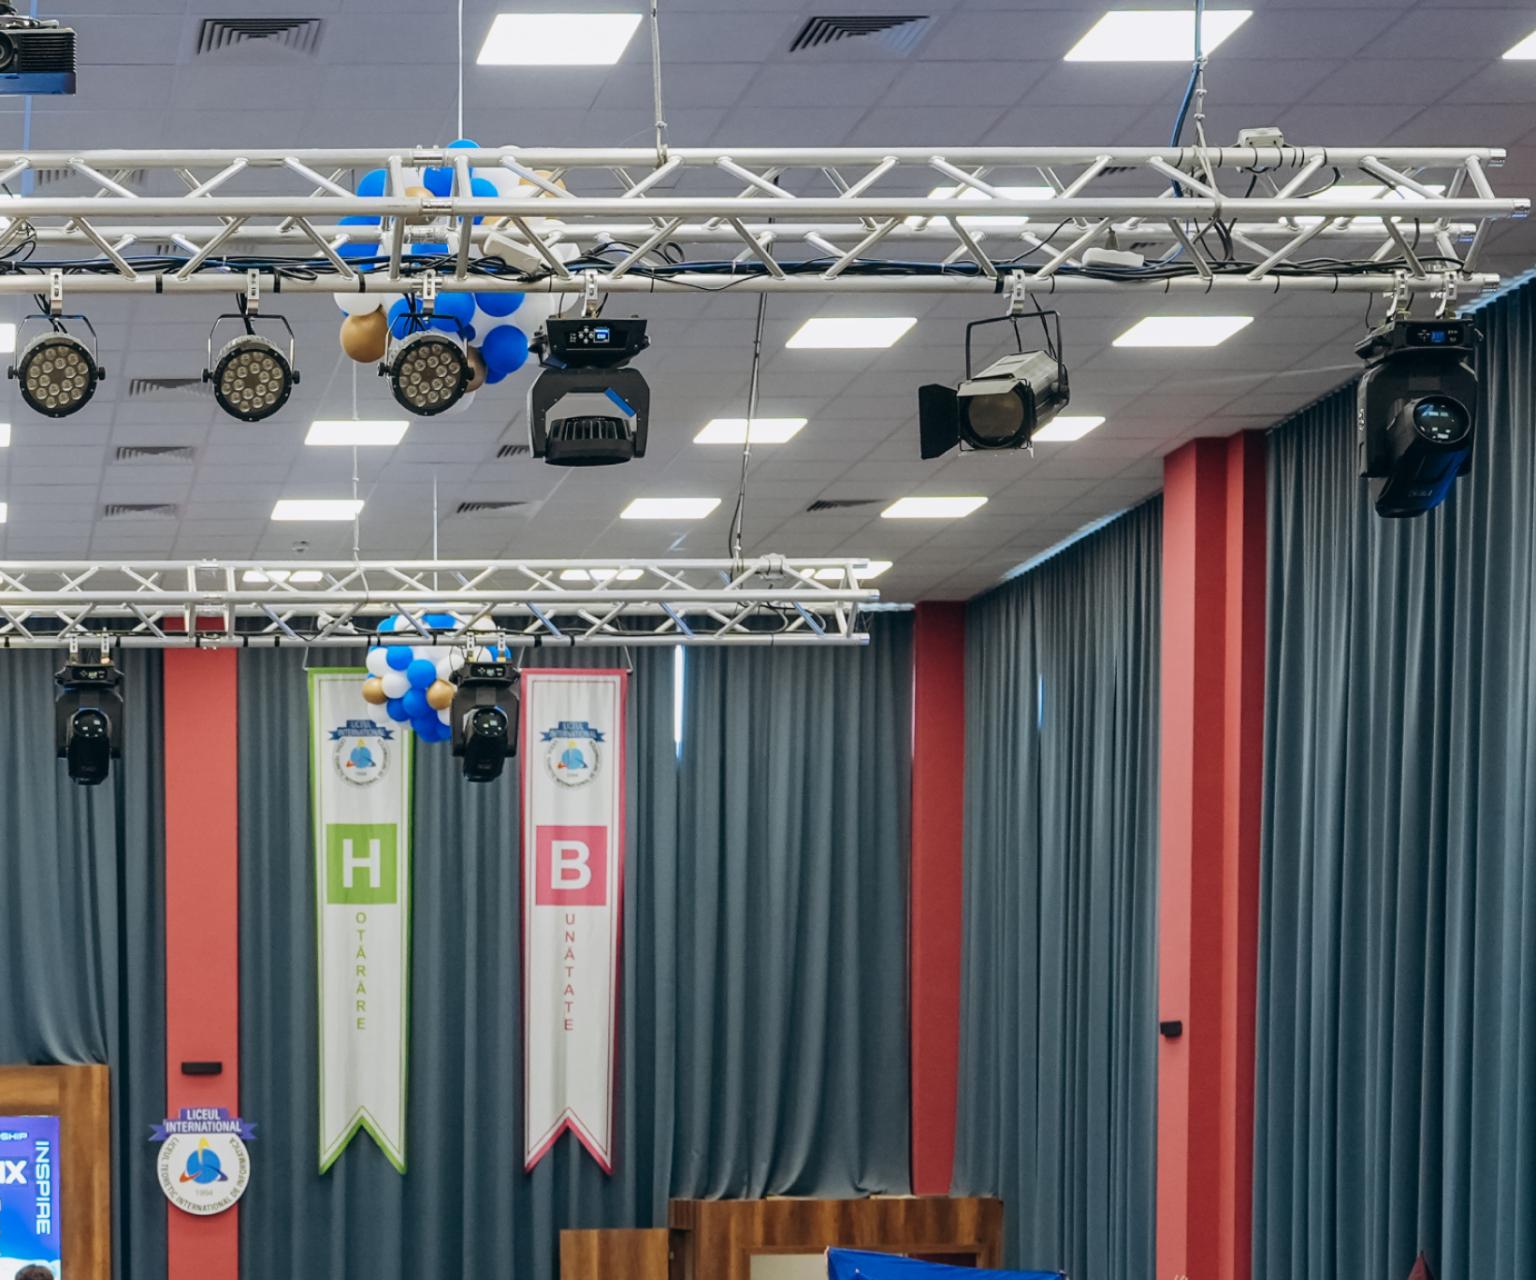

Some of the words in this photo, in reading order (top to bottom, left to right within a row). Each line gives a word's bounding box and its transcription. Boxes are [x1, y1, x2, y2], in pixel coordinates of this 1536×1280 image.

[342, 838, 381, 889] H
[550, 839, 593, 890] B
[165, 1119, 243, 1133] INTERNATIONAL
[186, 1108, 221, 1121] LICEUL
[35, 1140, 51, 1235] INSPIRE
